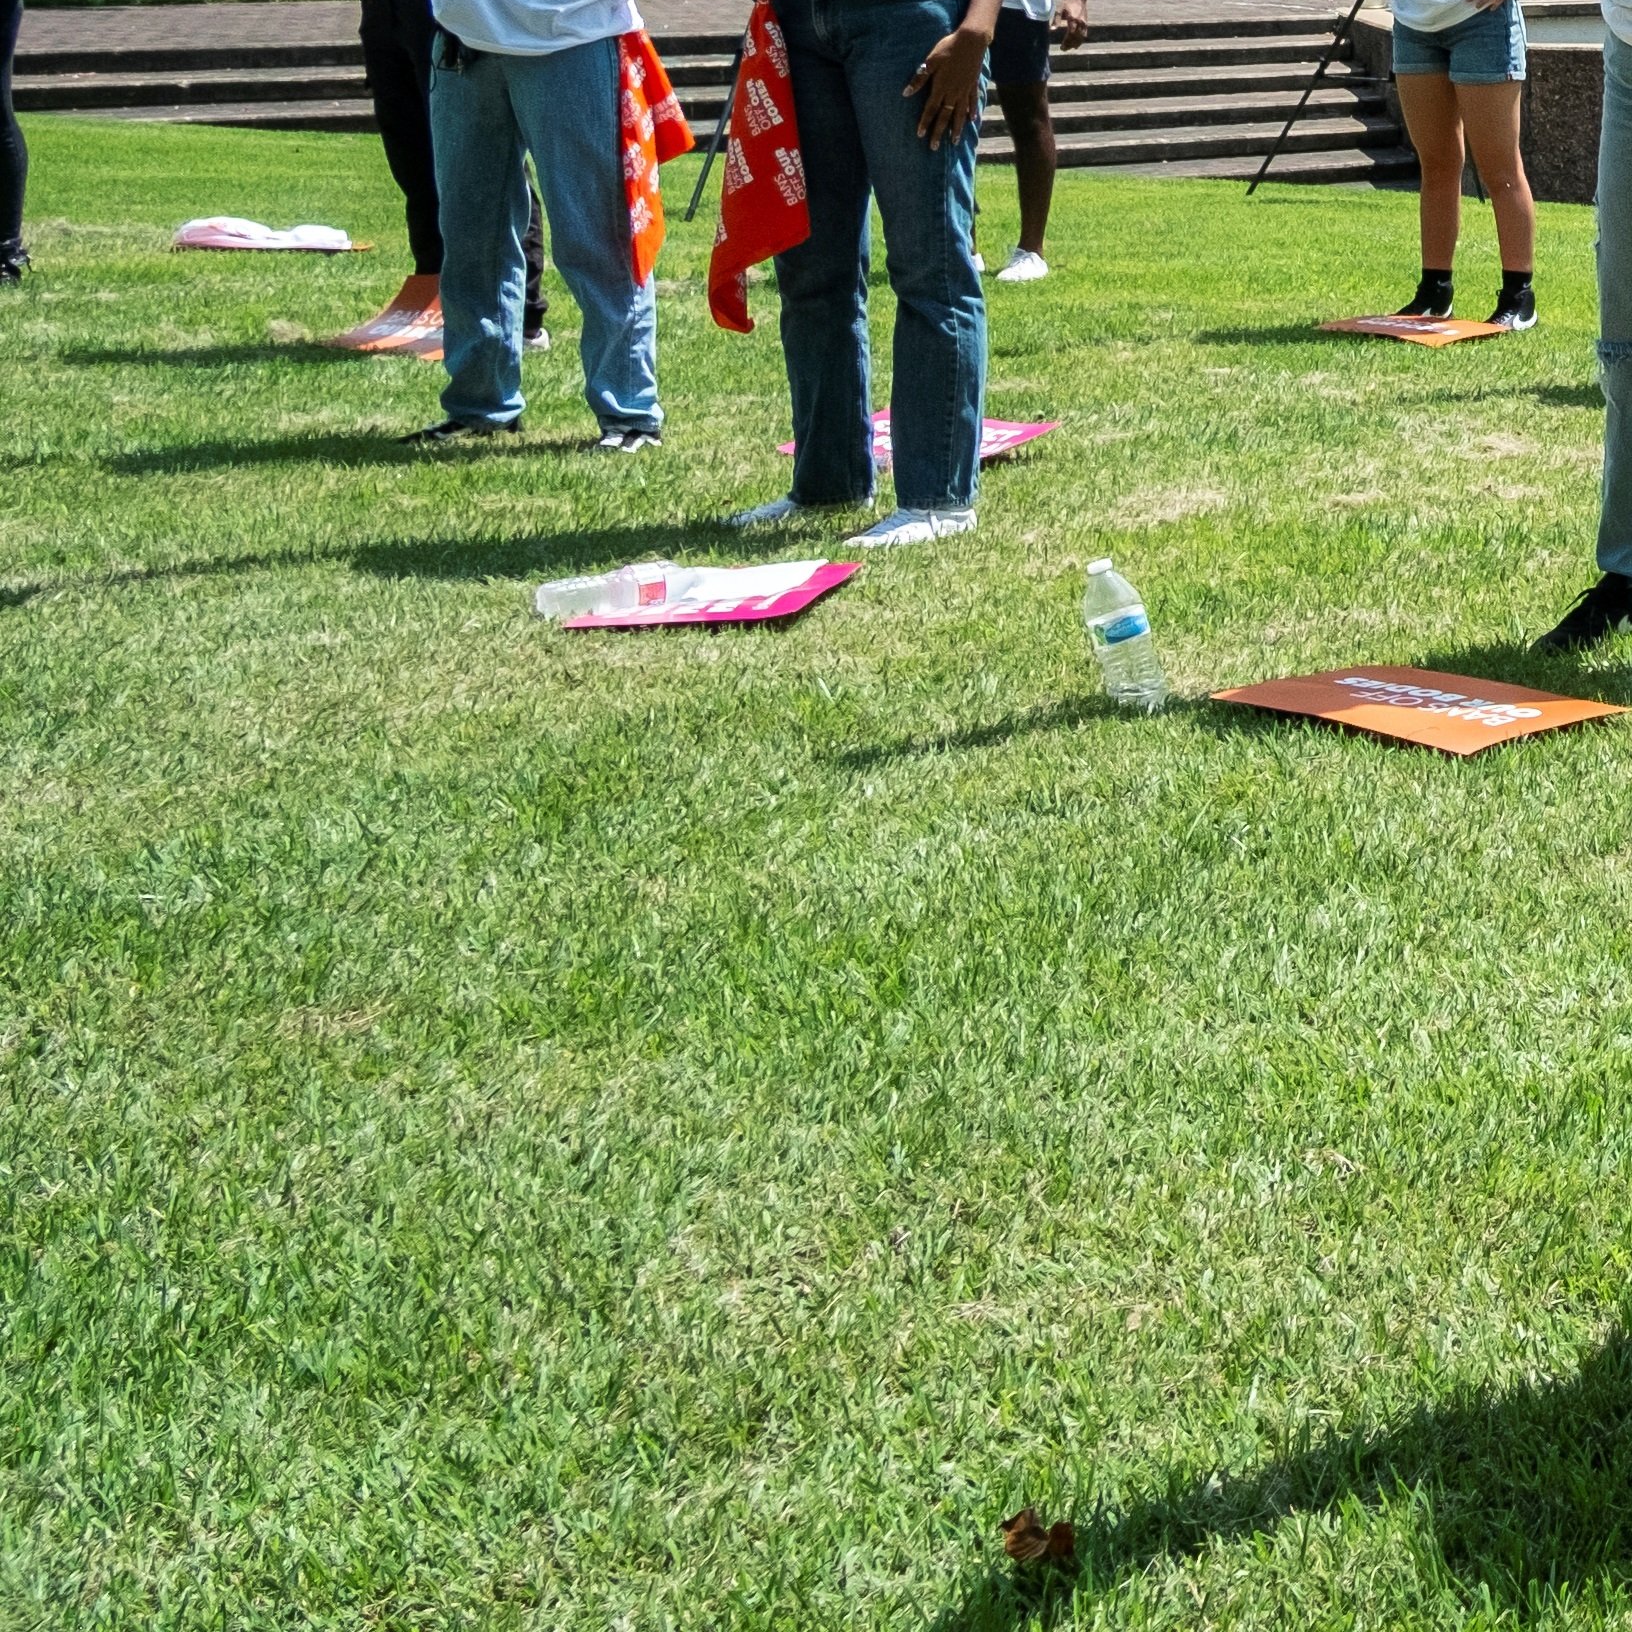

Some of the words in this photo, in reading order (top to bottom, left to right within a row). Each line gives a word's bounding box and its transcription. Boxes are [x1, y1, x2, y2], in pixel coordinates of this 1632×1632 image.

[746, 78, 760, 106] OUR
[755, 78, 784, 125] BODIES
[744, 104, 761, 136] BANS
[754, 109, 771, 130] OFF
[734, 137, 754, 184] BODIES
[775, 146, 797, 175] OUR
[774, 172, 799, 206] BANS
[1333, 676, 1469, 704] BODIES
[1349, 690, 1424, 706] OFF
[1417, 701, 1517, 727] BANS
[1457, 698, 1543, 719] OUR
